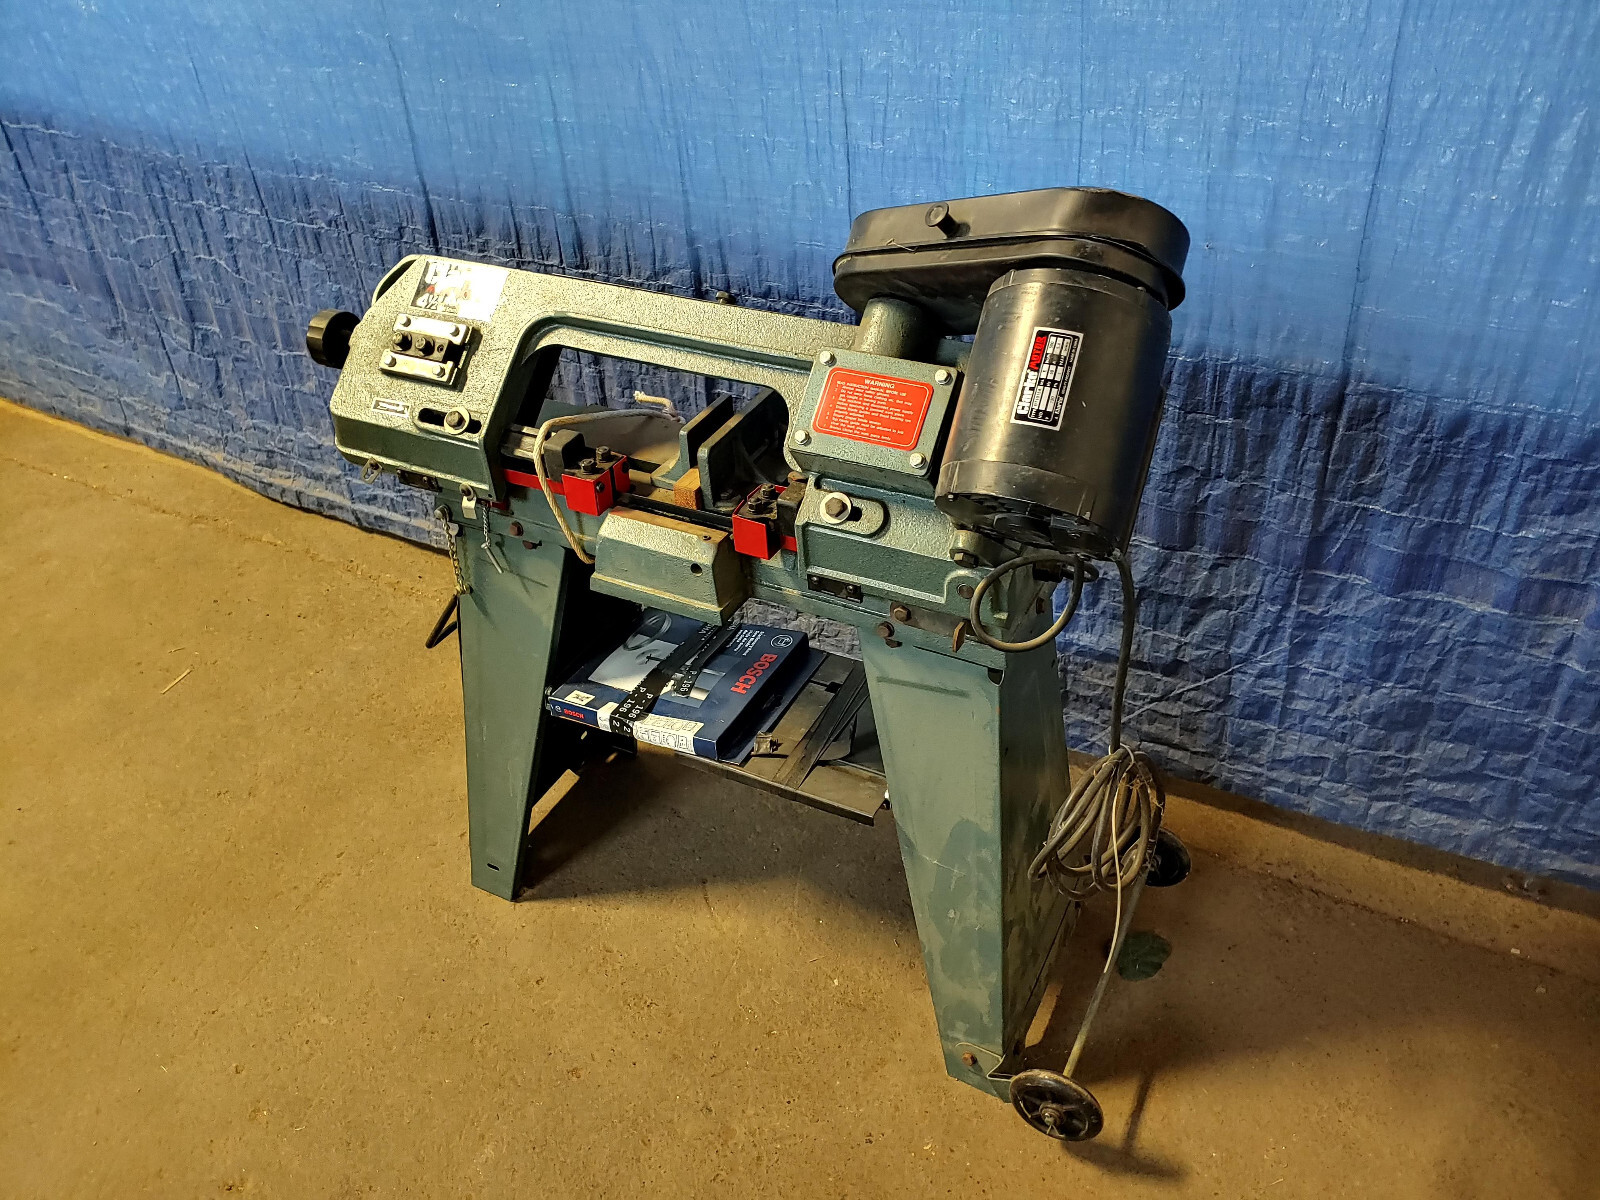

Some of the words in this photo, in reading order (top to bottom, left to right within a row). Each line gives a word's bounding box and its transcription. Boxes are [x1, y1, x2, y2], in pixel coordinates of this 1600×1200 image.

[1028, 336, 1047, 370] MOTOR
[864, 379, 895, 389] WARNING
[730, 653, 778, 695] BOSCH
[680, 680, 693, 692] 196
[619, 699, 635, 713] 196
[628, 705, 644, 719] 196
[563, 708, 584, 719] BOSCH
